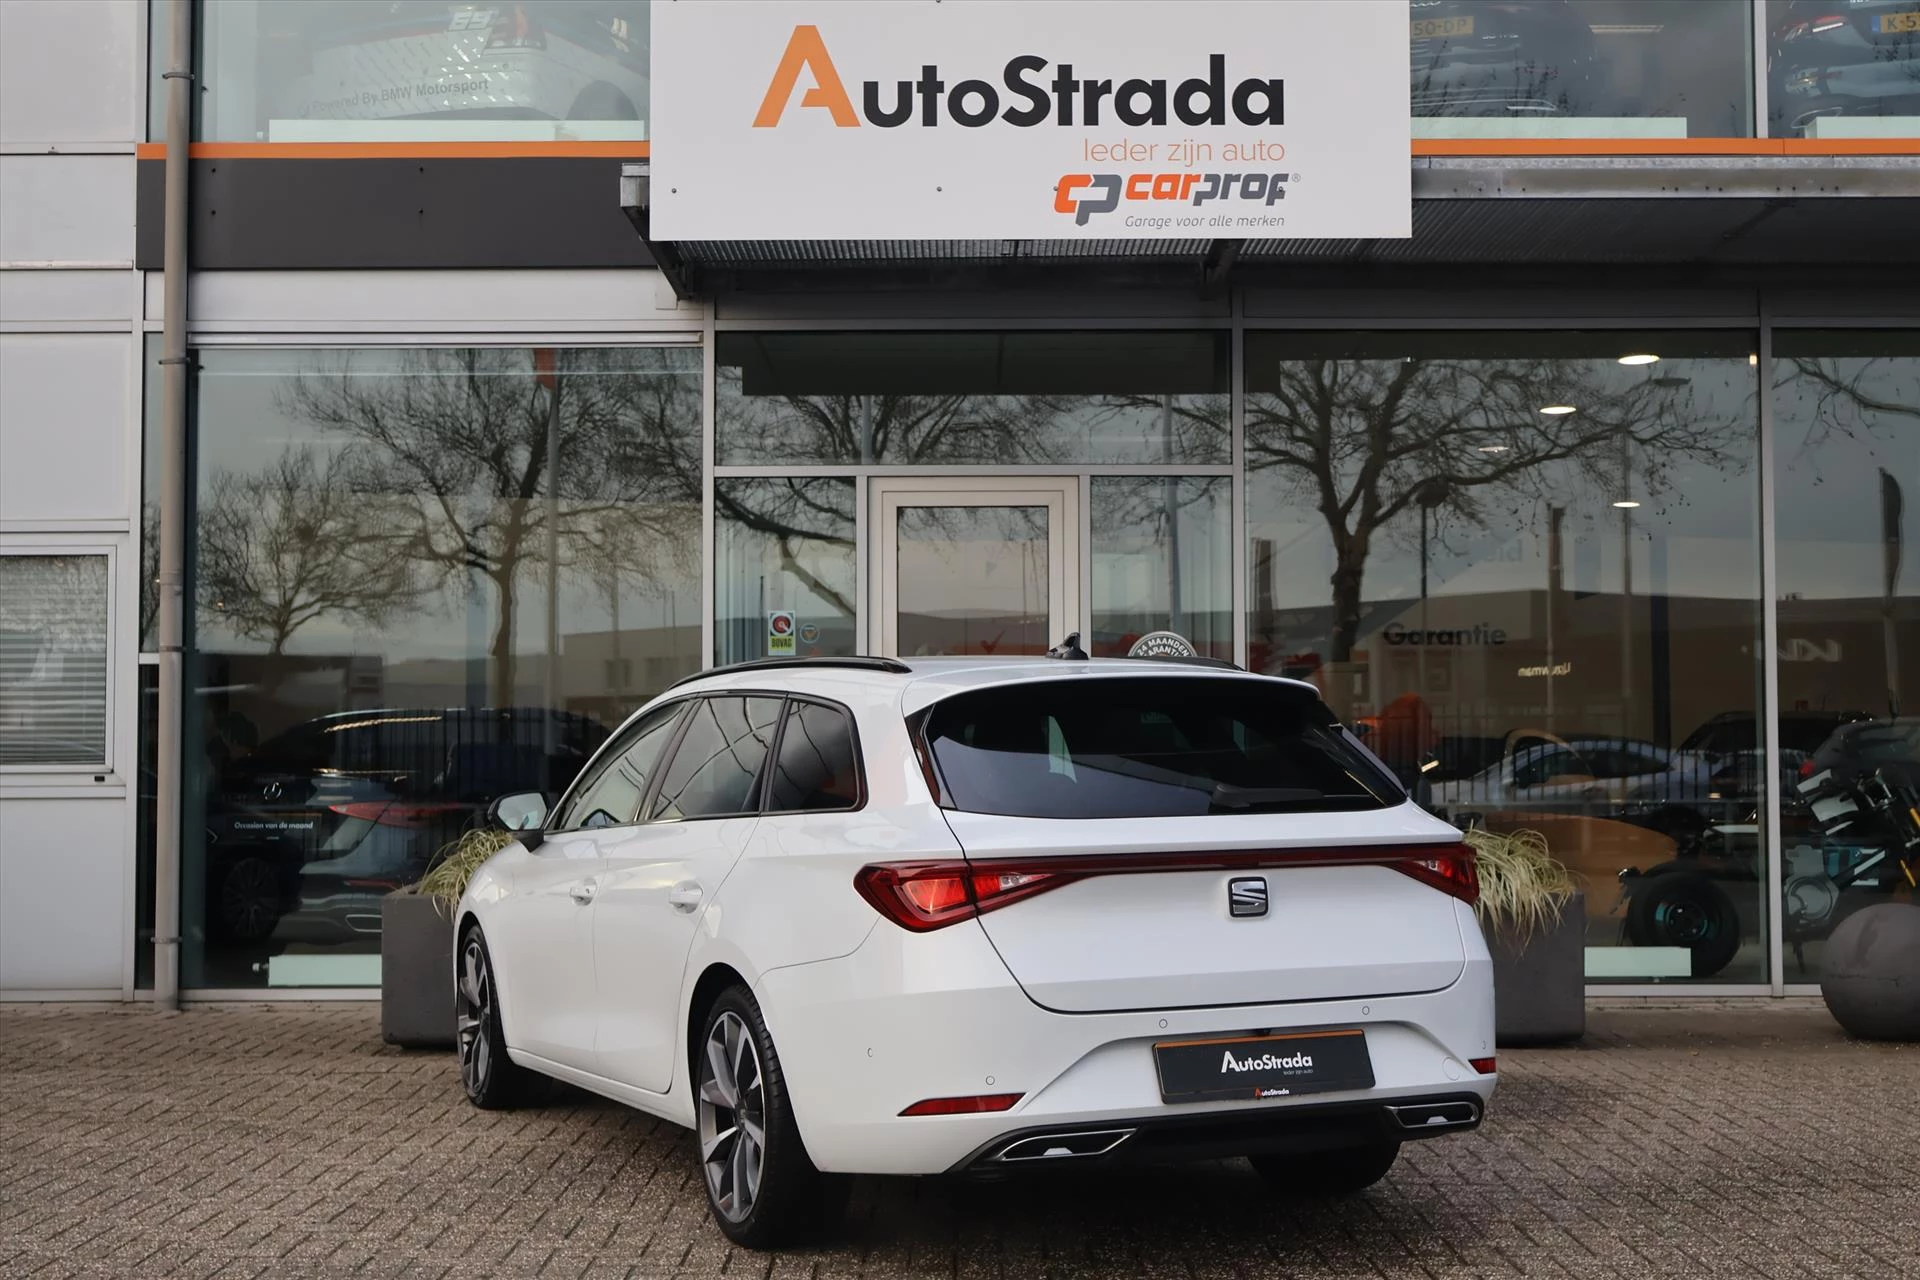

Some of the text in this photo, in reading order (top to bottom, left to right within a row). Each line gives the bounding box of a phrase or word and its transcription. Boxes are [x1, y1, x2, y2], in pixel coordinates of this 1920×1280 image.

[1887, 15, 1920, 31] K-5
[752, 25, 1285, 128] AutoStrada
[362, 91, 378, 106] By
[381, 86, 412, 101] BMW
[416, 79, 489, 97] Motorsport
[1083, 138, 1285, 167] Ieder zijn auto
[1125, 215, 1285, 229] Garage voor alle merken
[1383, 622, 1507, 646] Garantie
[1144, 645, 1182, 657] ARANTI
[1147, 637, 1190, 657] MAANDEN
[265, 822, 276, 830] van
[278, 821, 288, 830] de
[288, 821, 314, 830] maand
[1221, 1050, 1313, 1073] AutoStrada
[1255, 1087, 1290, 1097] AutoStrada
